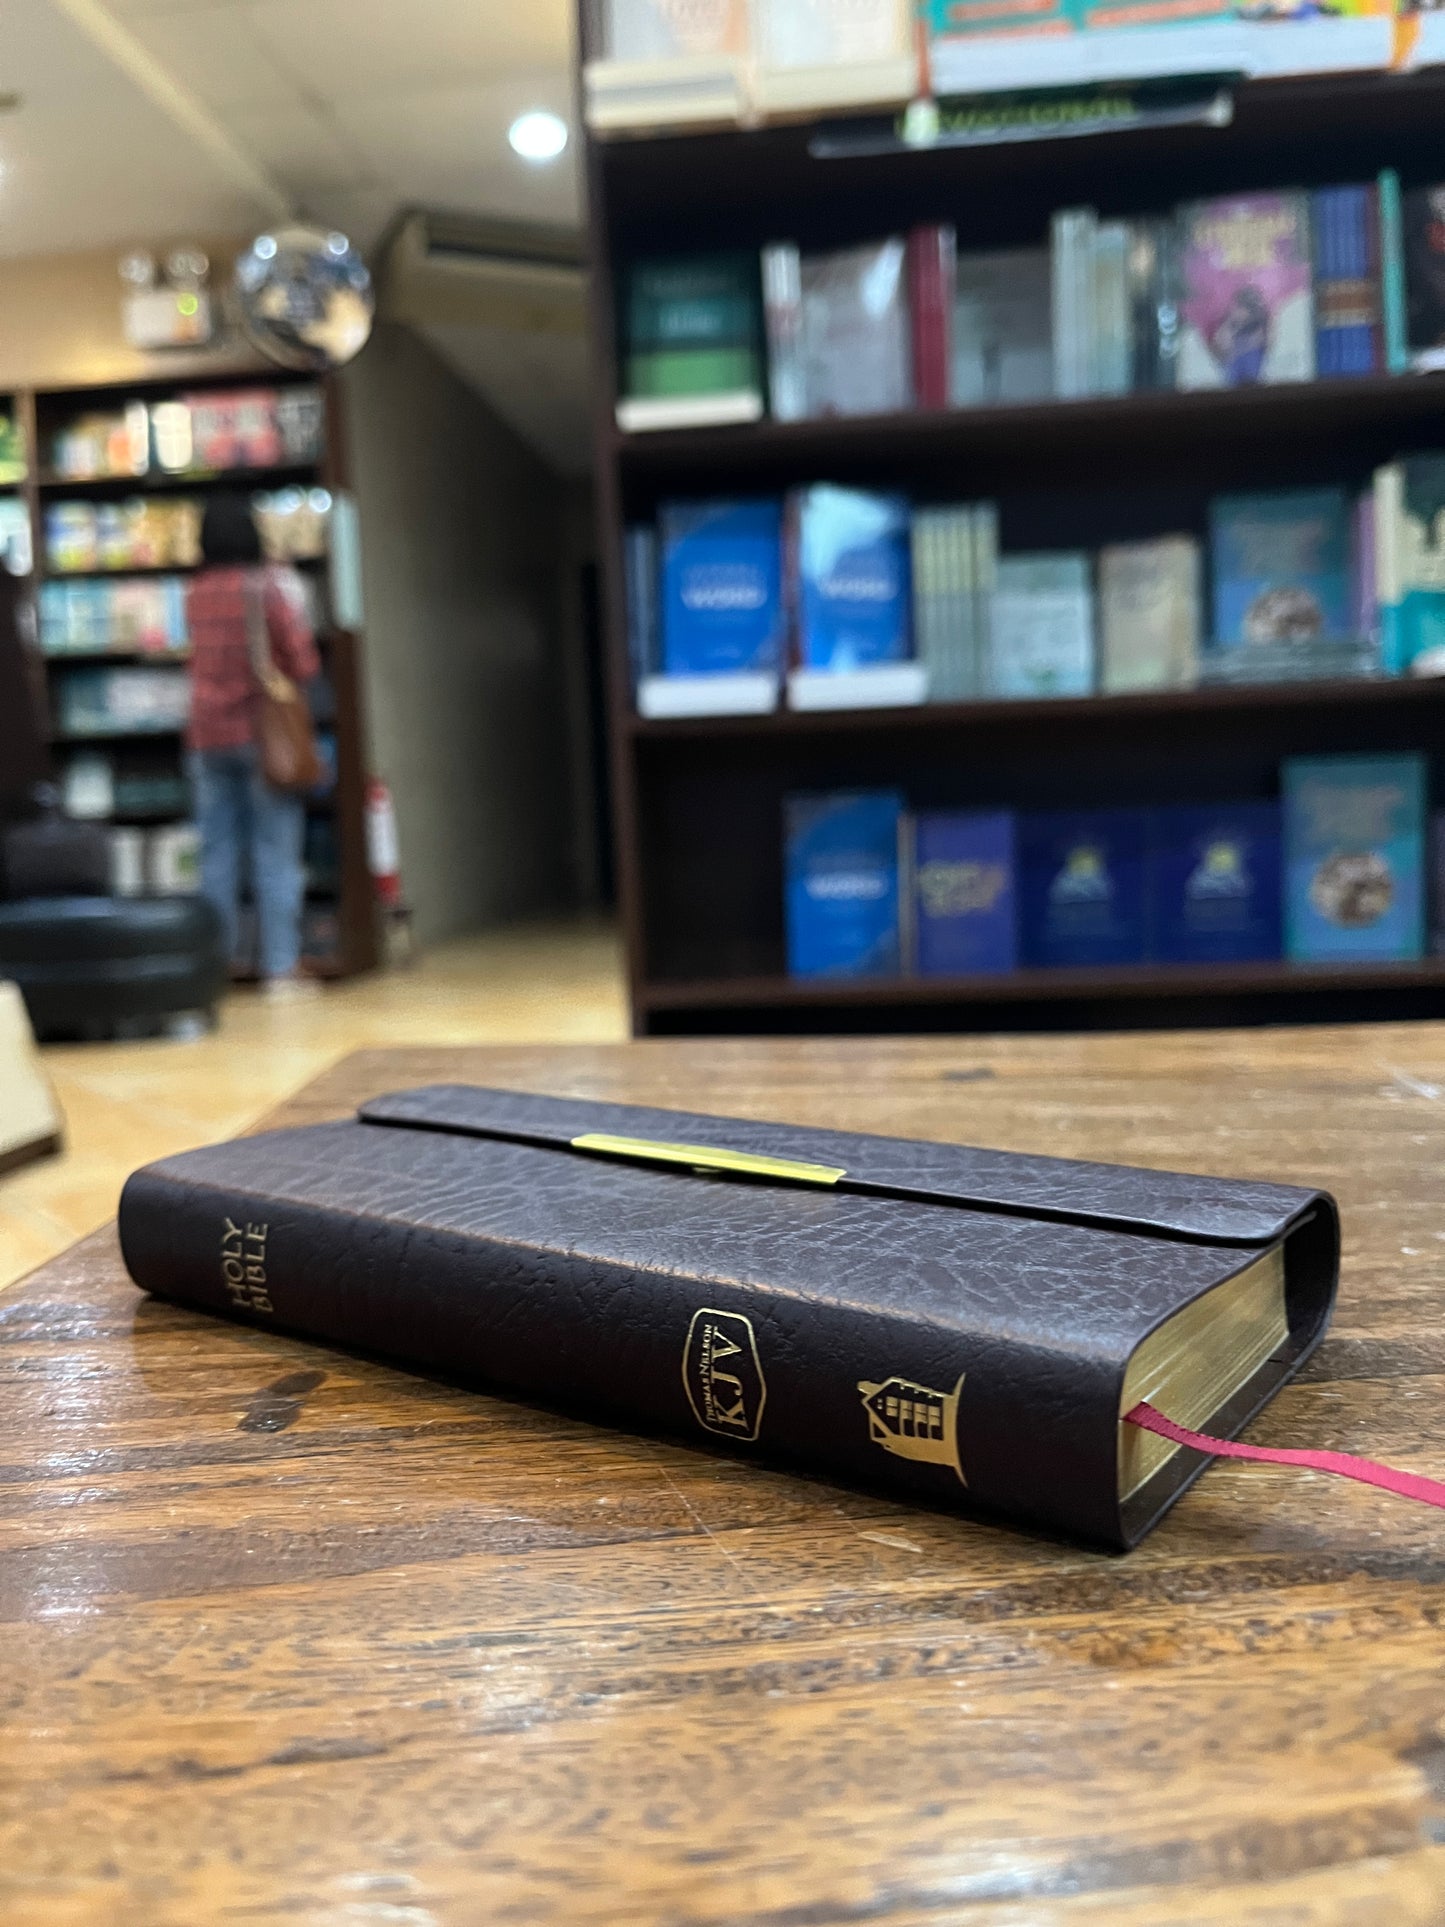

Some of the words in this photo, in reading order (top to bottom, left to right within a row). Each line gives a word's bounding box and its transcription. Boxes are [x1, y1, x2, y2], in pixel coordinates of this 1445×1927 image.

[221, 1216, 251, 1307] HOLY
[245, 1221, 274, 1312] BIBLE
[699, 1324, 713, 1375] NELSON
[711, 1326, 748, 1430] KJV
